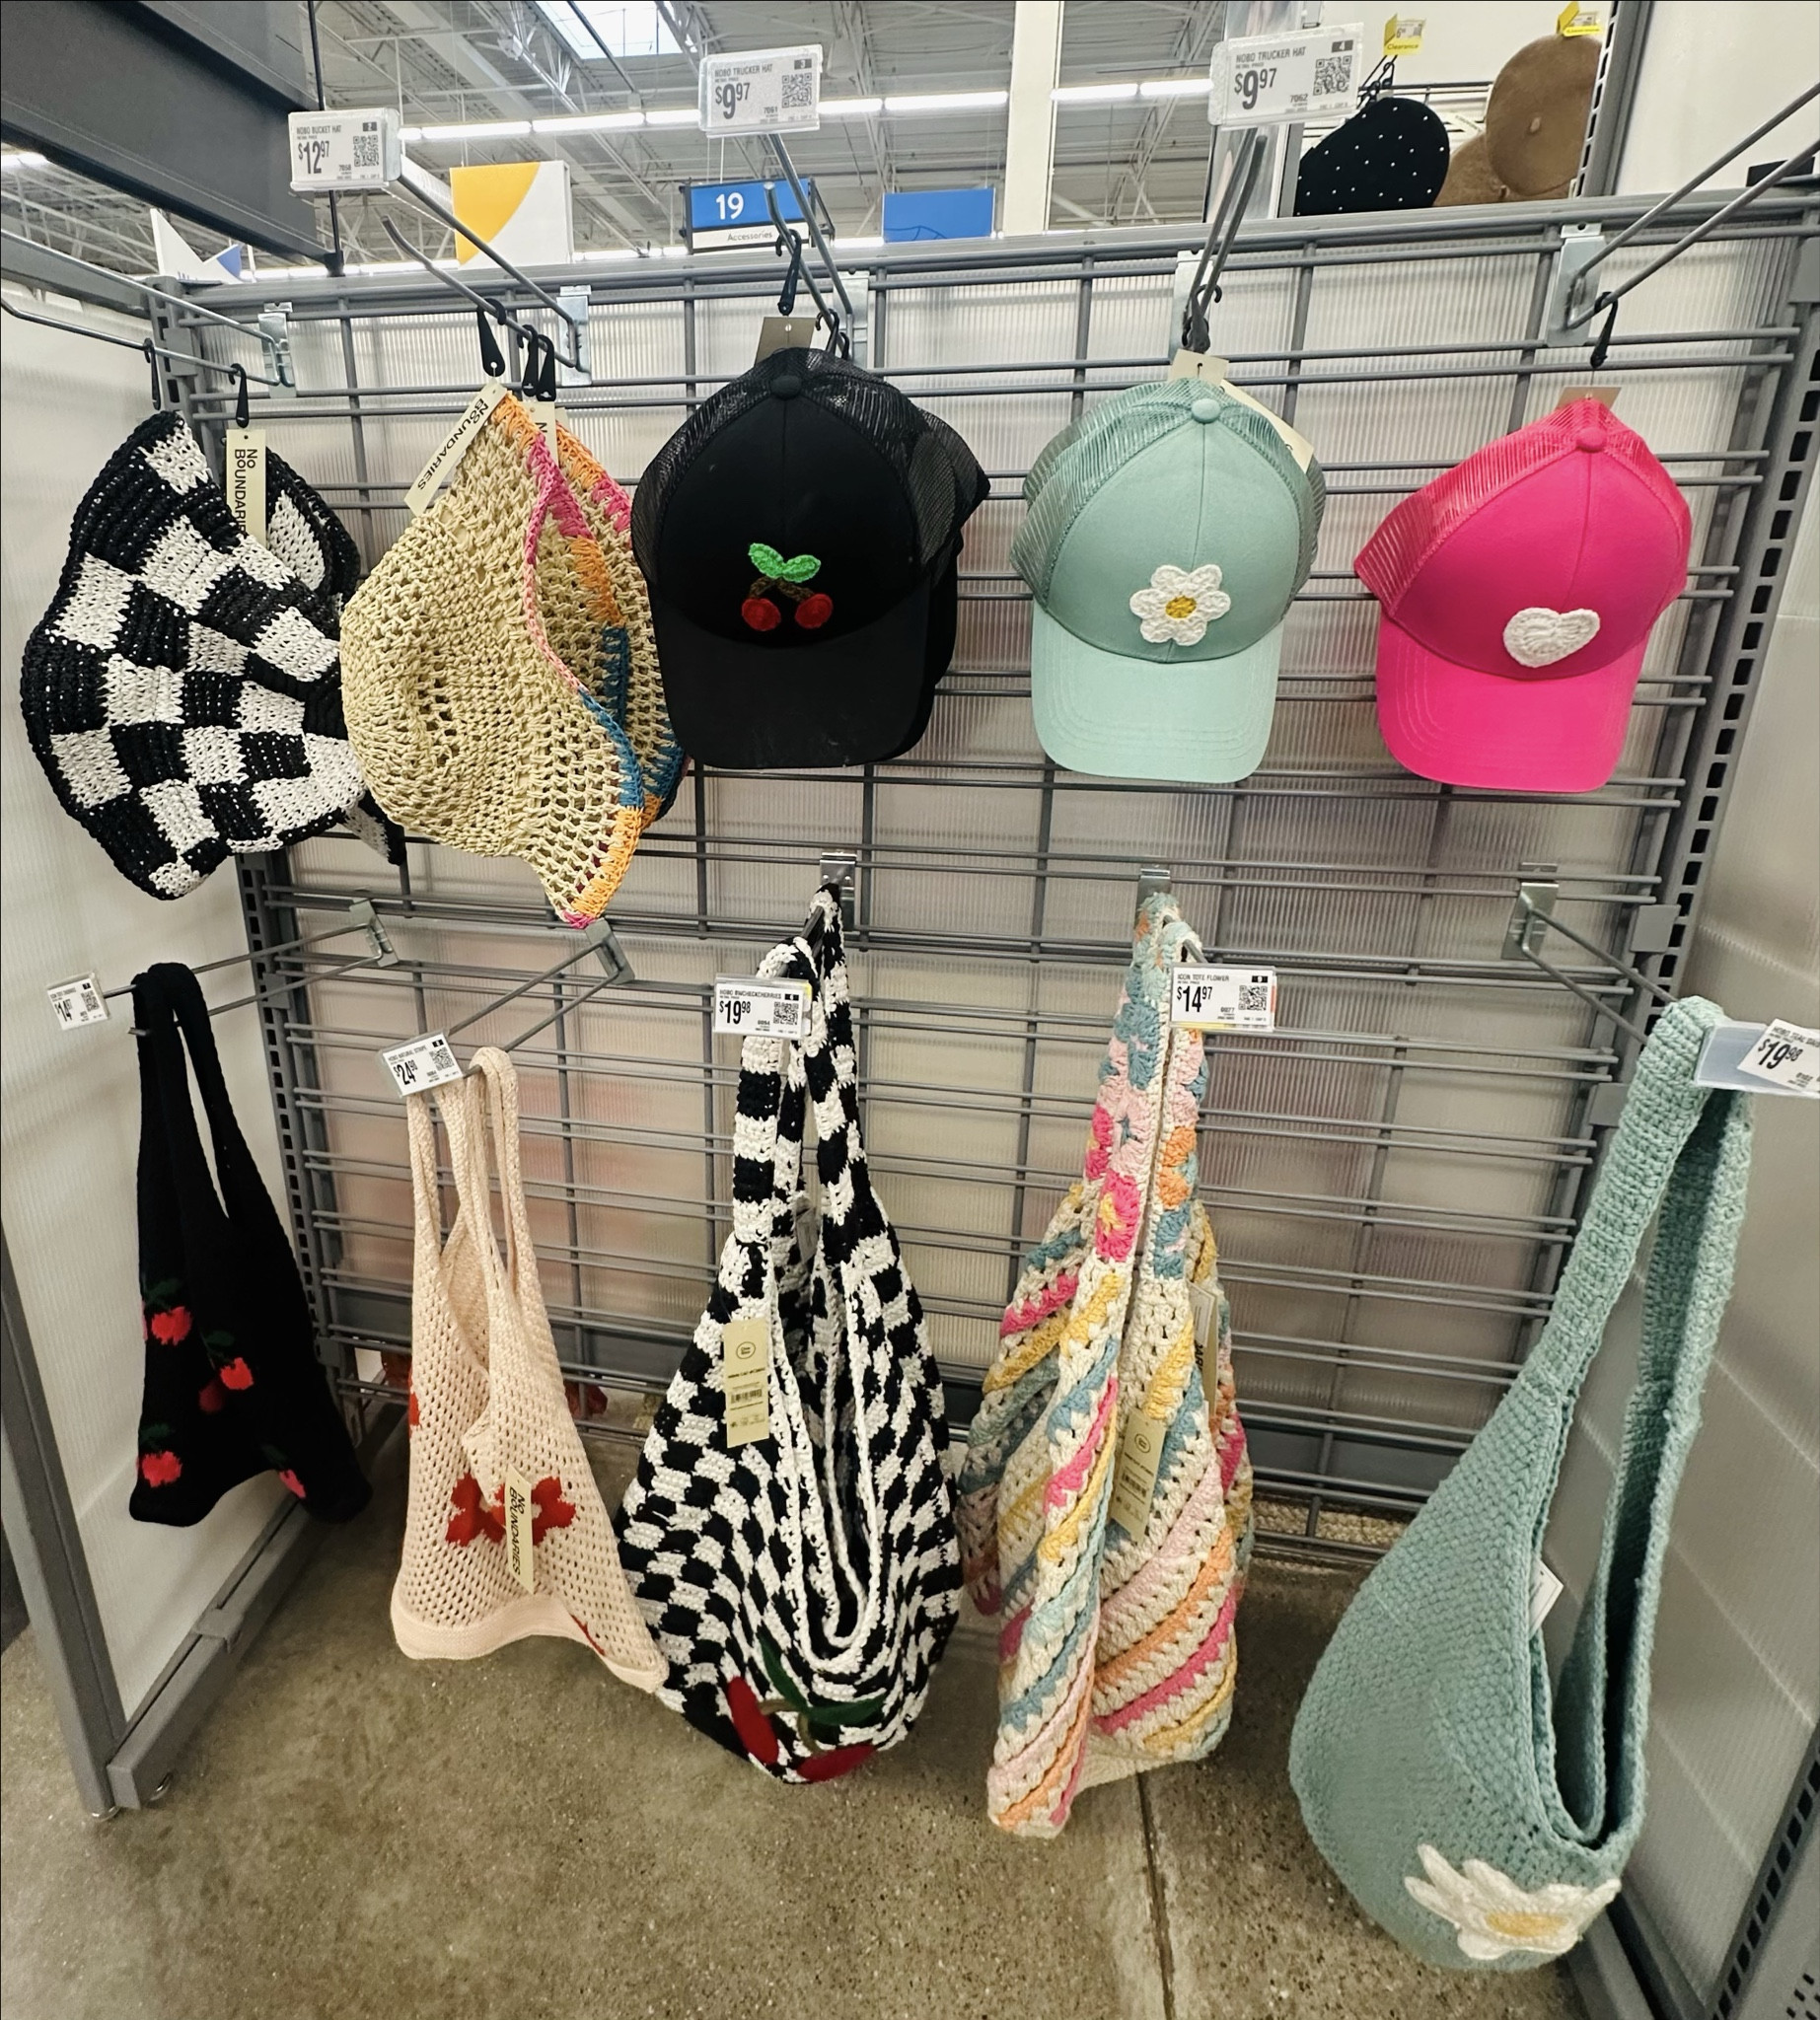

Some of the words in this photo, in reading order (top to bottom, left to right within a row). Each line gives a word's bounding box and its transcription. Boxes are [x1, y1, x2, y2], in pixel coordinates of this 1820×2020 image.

[1258, 48, 1290, 61] TRUCKER
[1292, 46, 1306, 57] HAT
[733, 65, 760, 75] TRUCKER
[763, 64, 773, 73] HAT
[312, 125, 330, 134] BUCKET
[716, 192, 744, 220] 19
[727, 229, 772, 242] Accessories
[473, 402, 489, 424] NO
[417, 397, 484, 490] BOUNDARIES
[247, 449, 257, 469] NO
[517, 1492, 526, 1515] NO
[509, 1485, 521, 1575] BOUNDARIES
